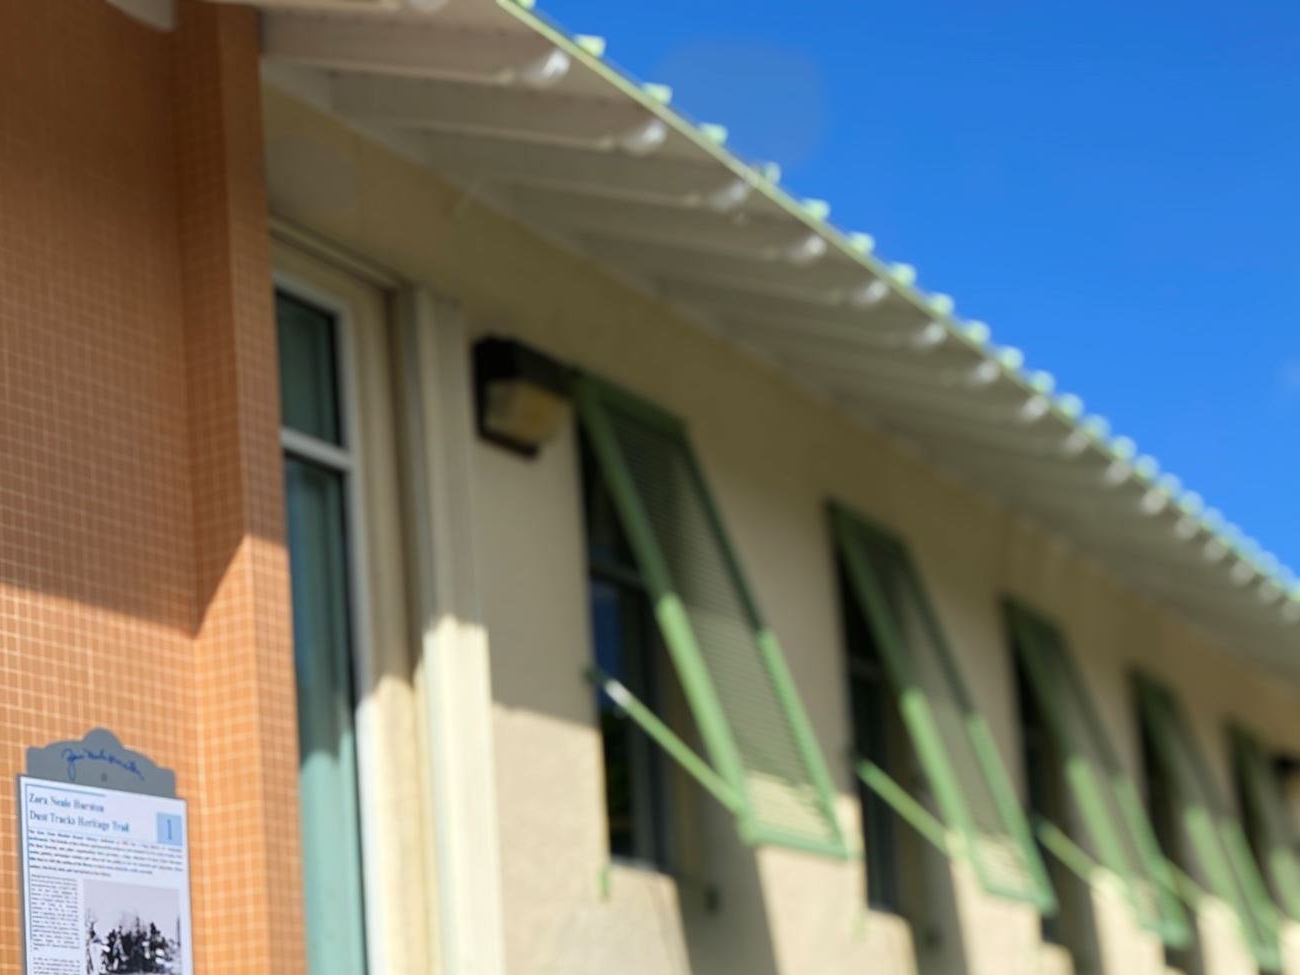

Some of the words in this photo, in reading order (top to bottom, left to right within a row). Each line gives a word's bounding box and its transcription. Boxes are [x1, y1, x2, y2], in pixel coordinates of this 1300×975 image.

[29, 793, 48, 806] Zora
[50, 795, 71, 808] Neale
[74, 798, 104, 812] Hurston
[29, 810, 47, 822] Dust
[49, 812, 76, 826] Tracks
[78, 816, 110, 831] Heritage
[112, 820, 129, 833] Trail
[166, 818, 173, 841] 1
